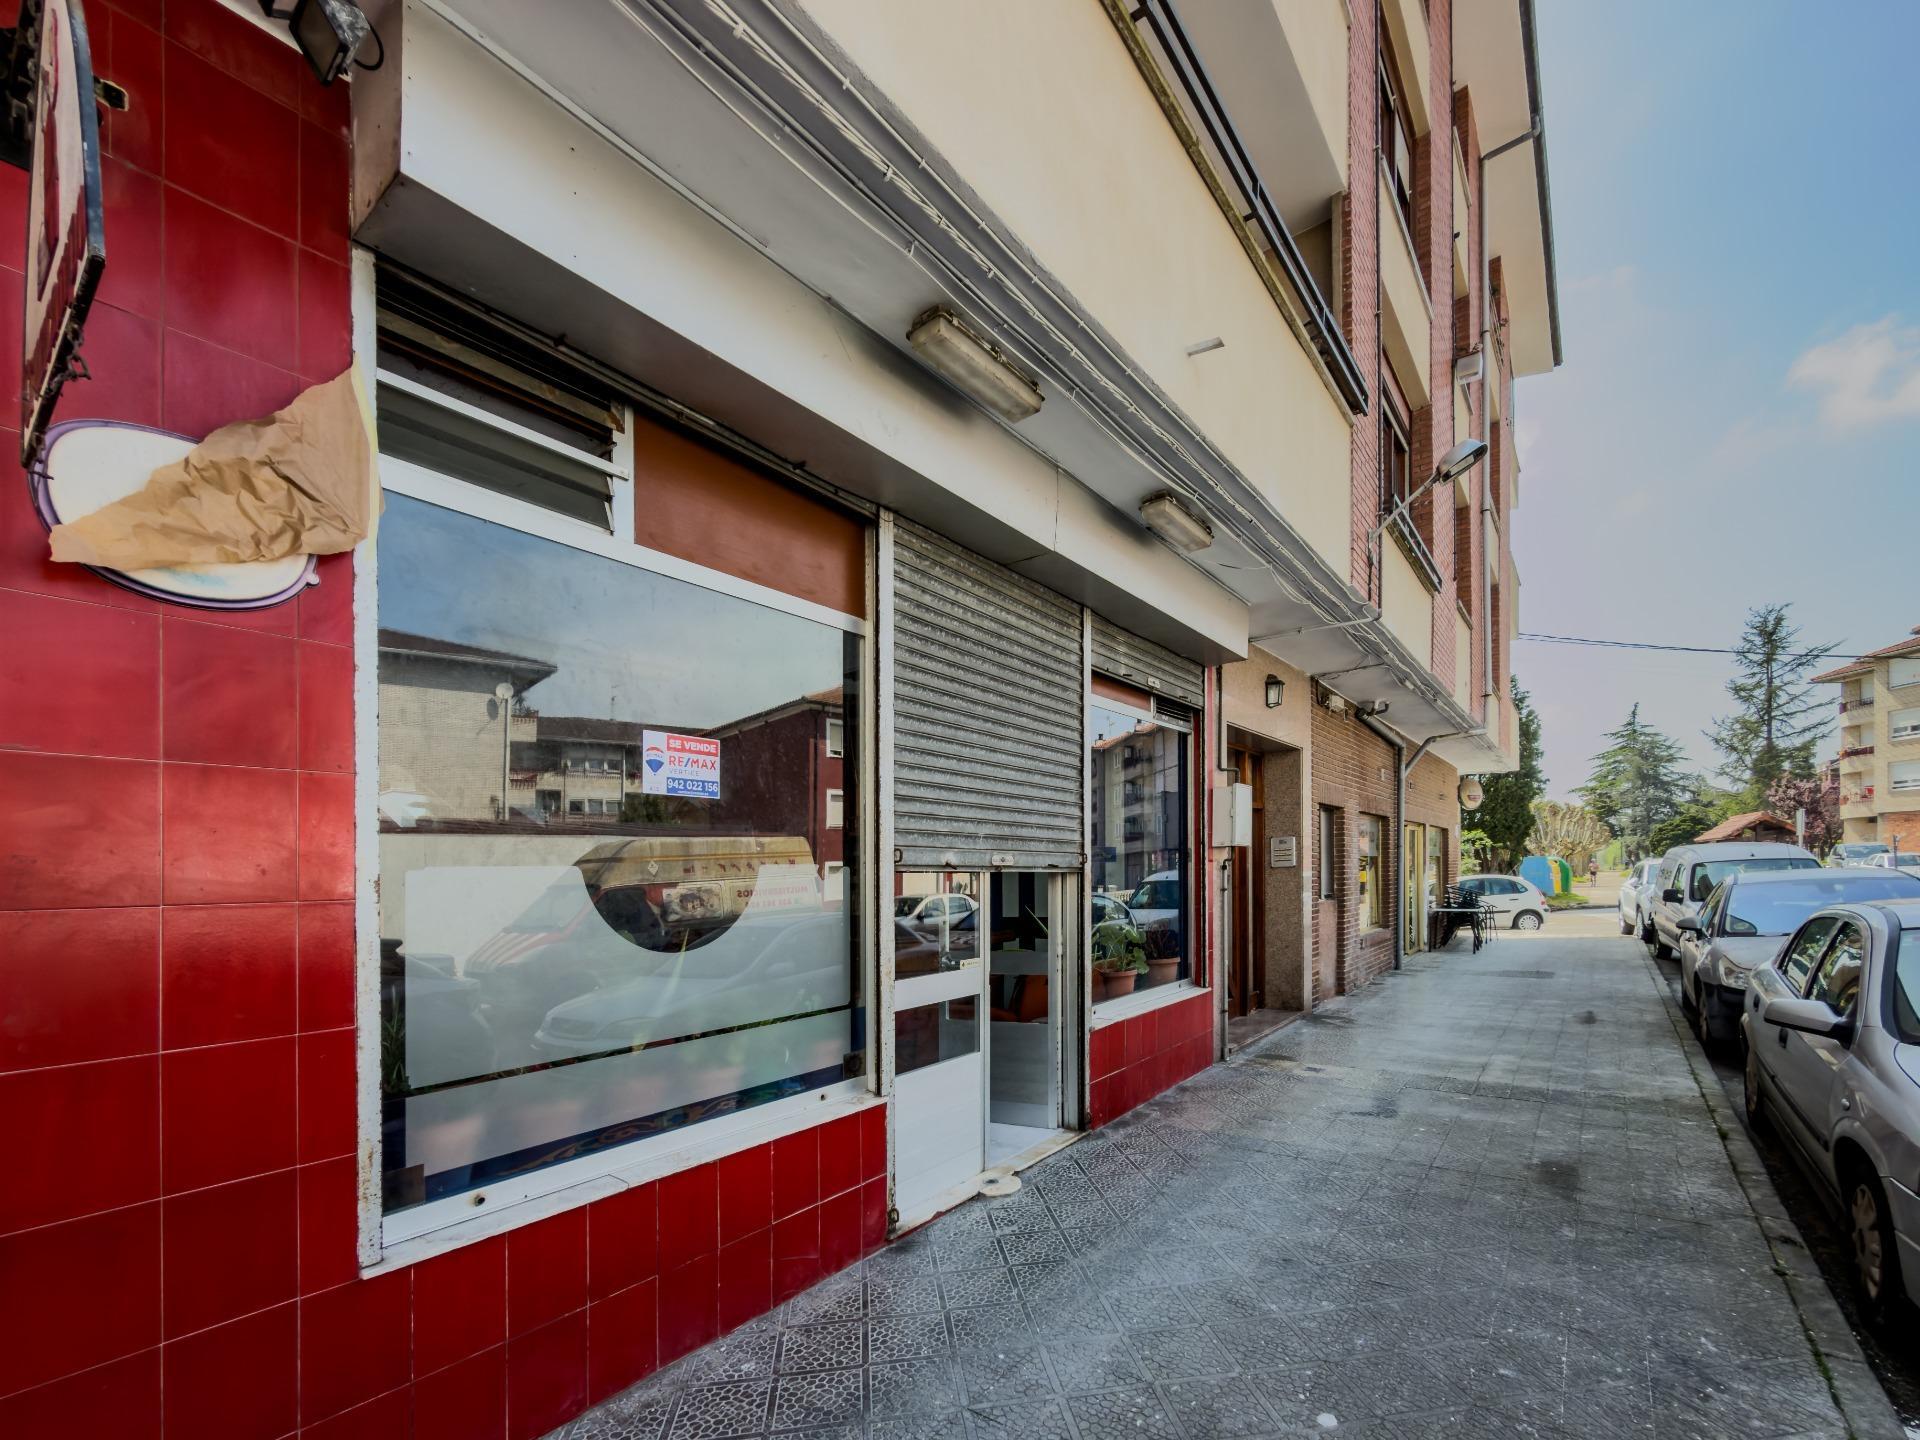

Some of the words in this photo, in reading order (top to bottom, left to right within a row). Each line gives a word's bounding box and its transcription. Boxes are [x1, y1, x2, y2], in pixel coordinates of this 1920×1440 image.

[669, 739, 681, 749] SE
[684, 741, 717, 753] VENDE
[669, 755, 716, 770] RE/MAX
[668, 779, 685, 789] 942
[687, 781, 703, 791] 022
[705, 783, 718, 792] 156
